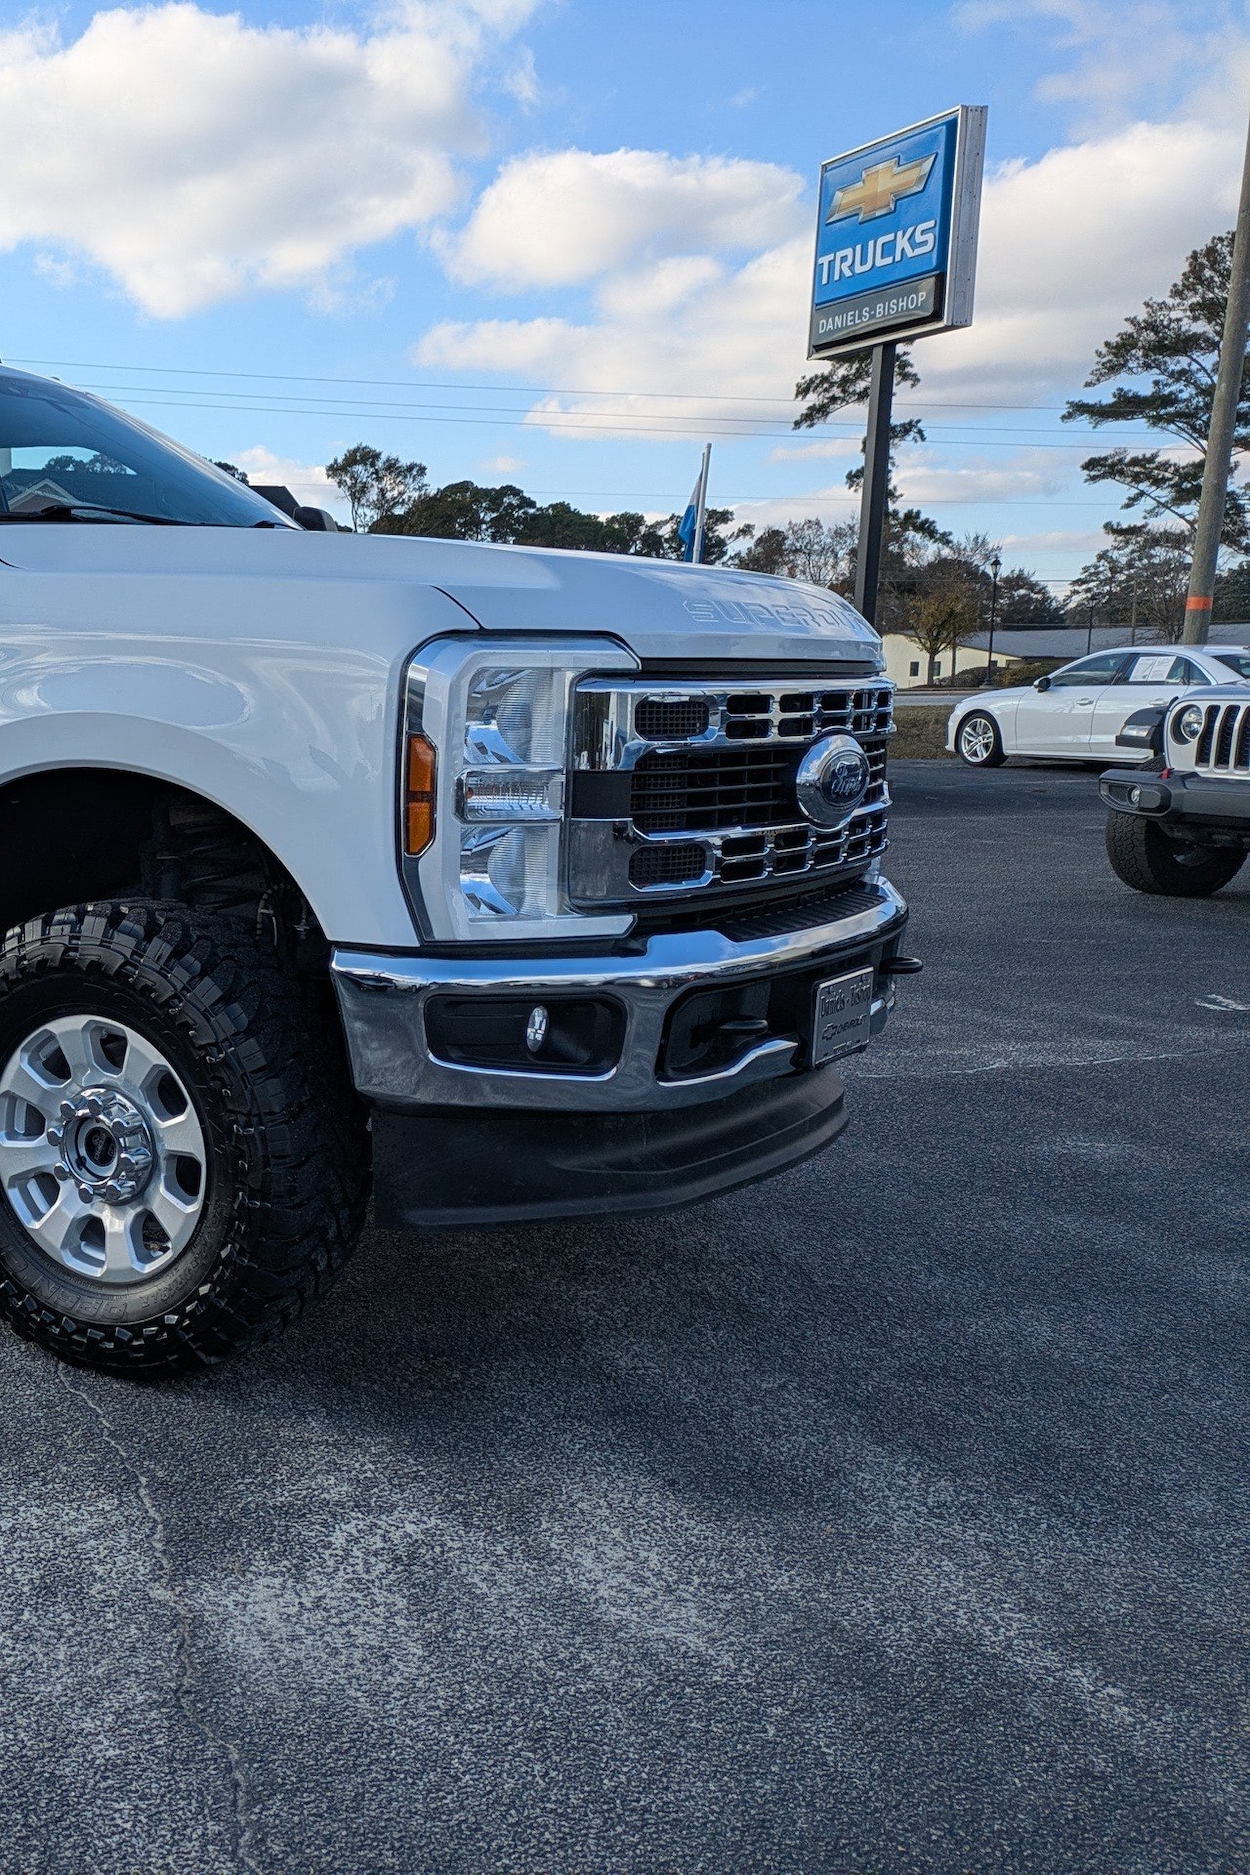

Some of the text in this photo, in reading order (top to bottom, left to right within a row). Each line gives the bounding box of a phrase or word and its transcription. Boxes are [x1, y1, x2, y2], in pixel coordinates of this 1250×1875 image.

[818, 219, 937, 286] TRUCKS
[818, 291, 927, 334] DANIELS-BISHOP
[682, 599, 820, 628] SUPER
